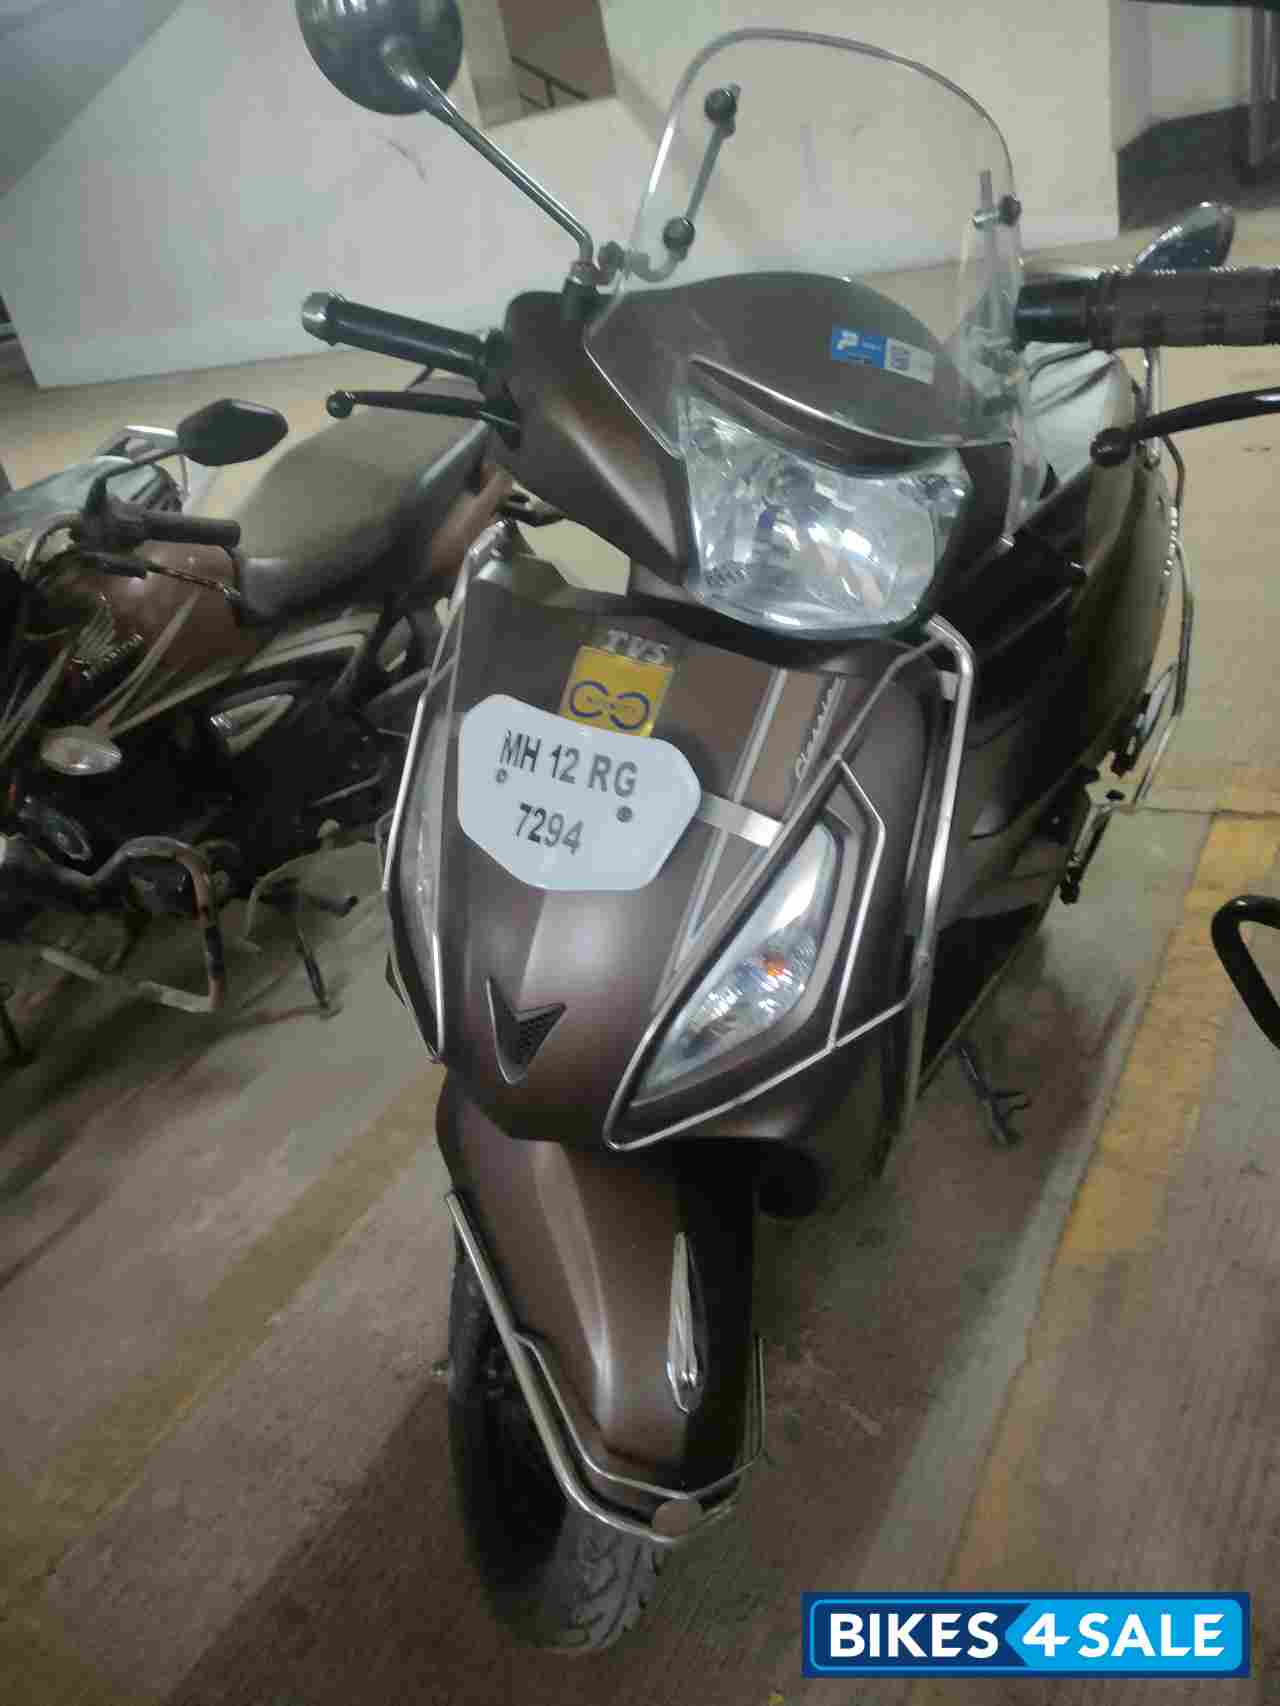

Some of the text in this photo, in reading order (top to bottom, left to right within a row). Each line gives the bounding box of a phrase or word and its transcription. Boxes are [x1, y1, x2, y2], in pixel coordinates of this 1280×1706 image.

[499, 730, 638, 798] MH 12 RG
[515, 802, 584, 856] 7294
